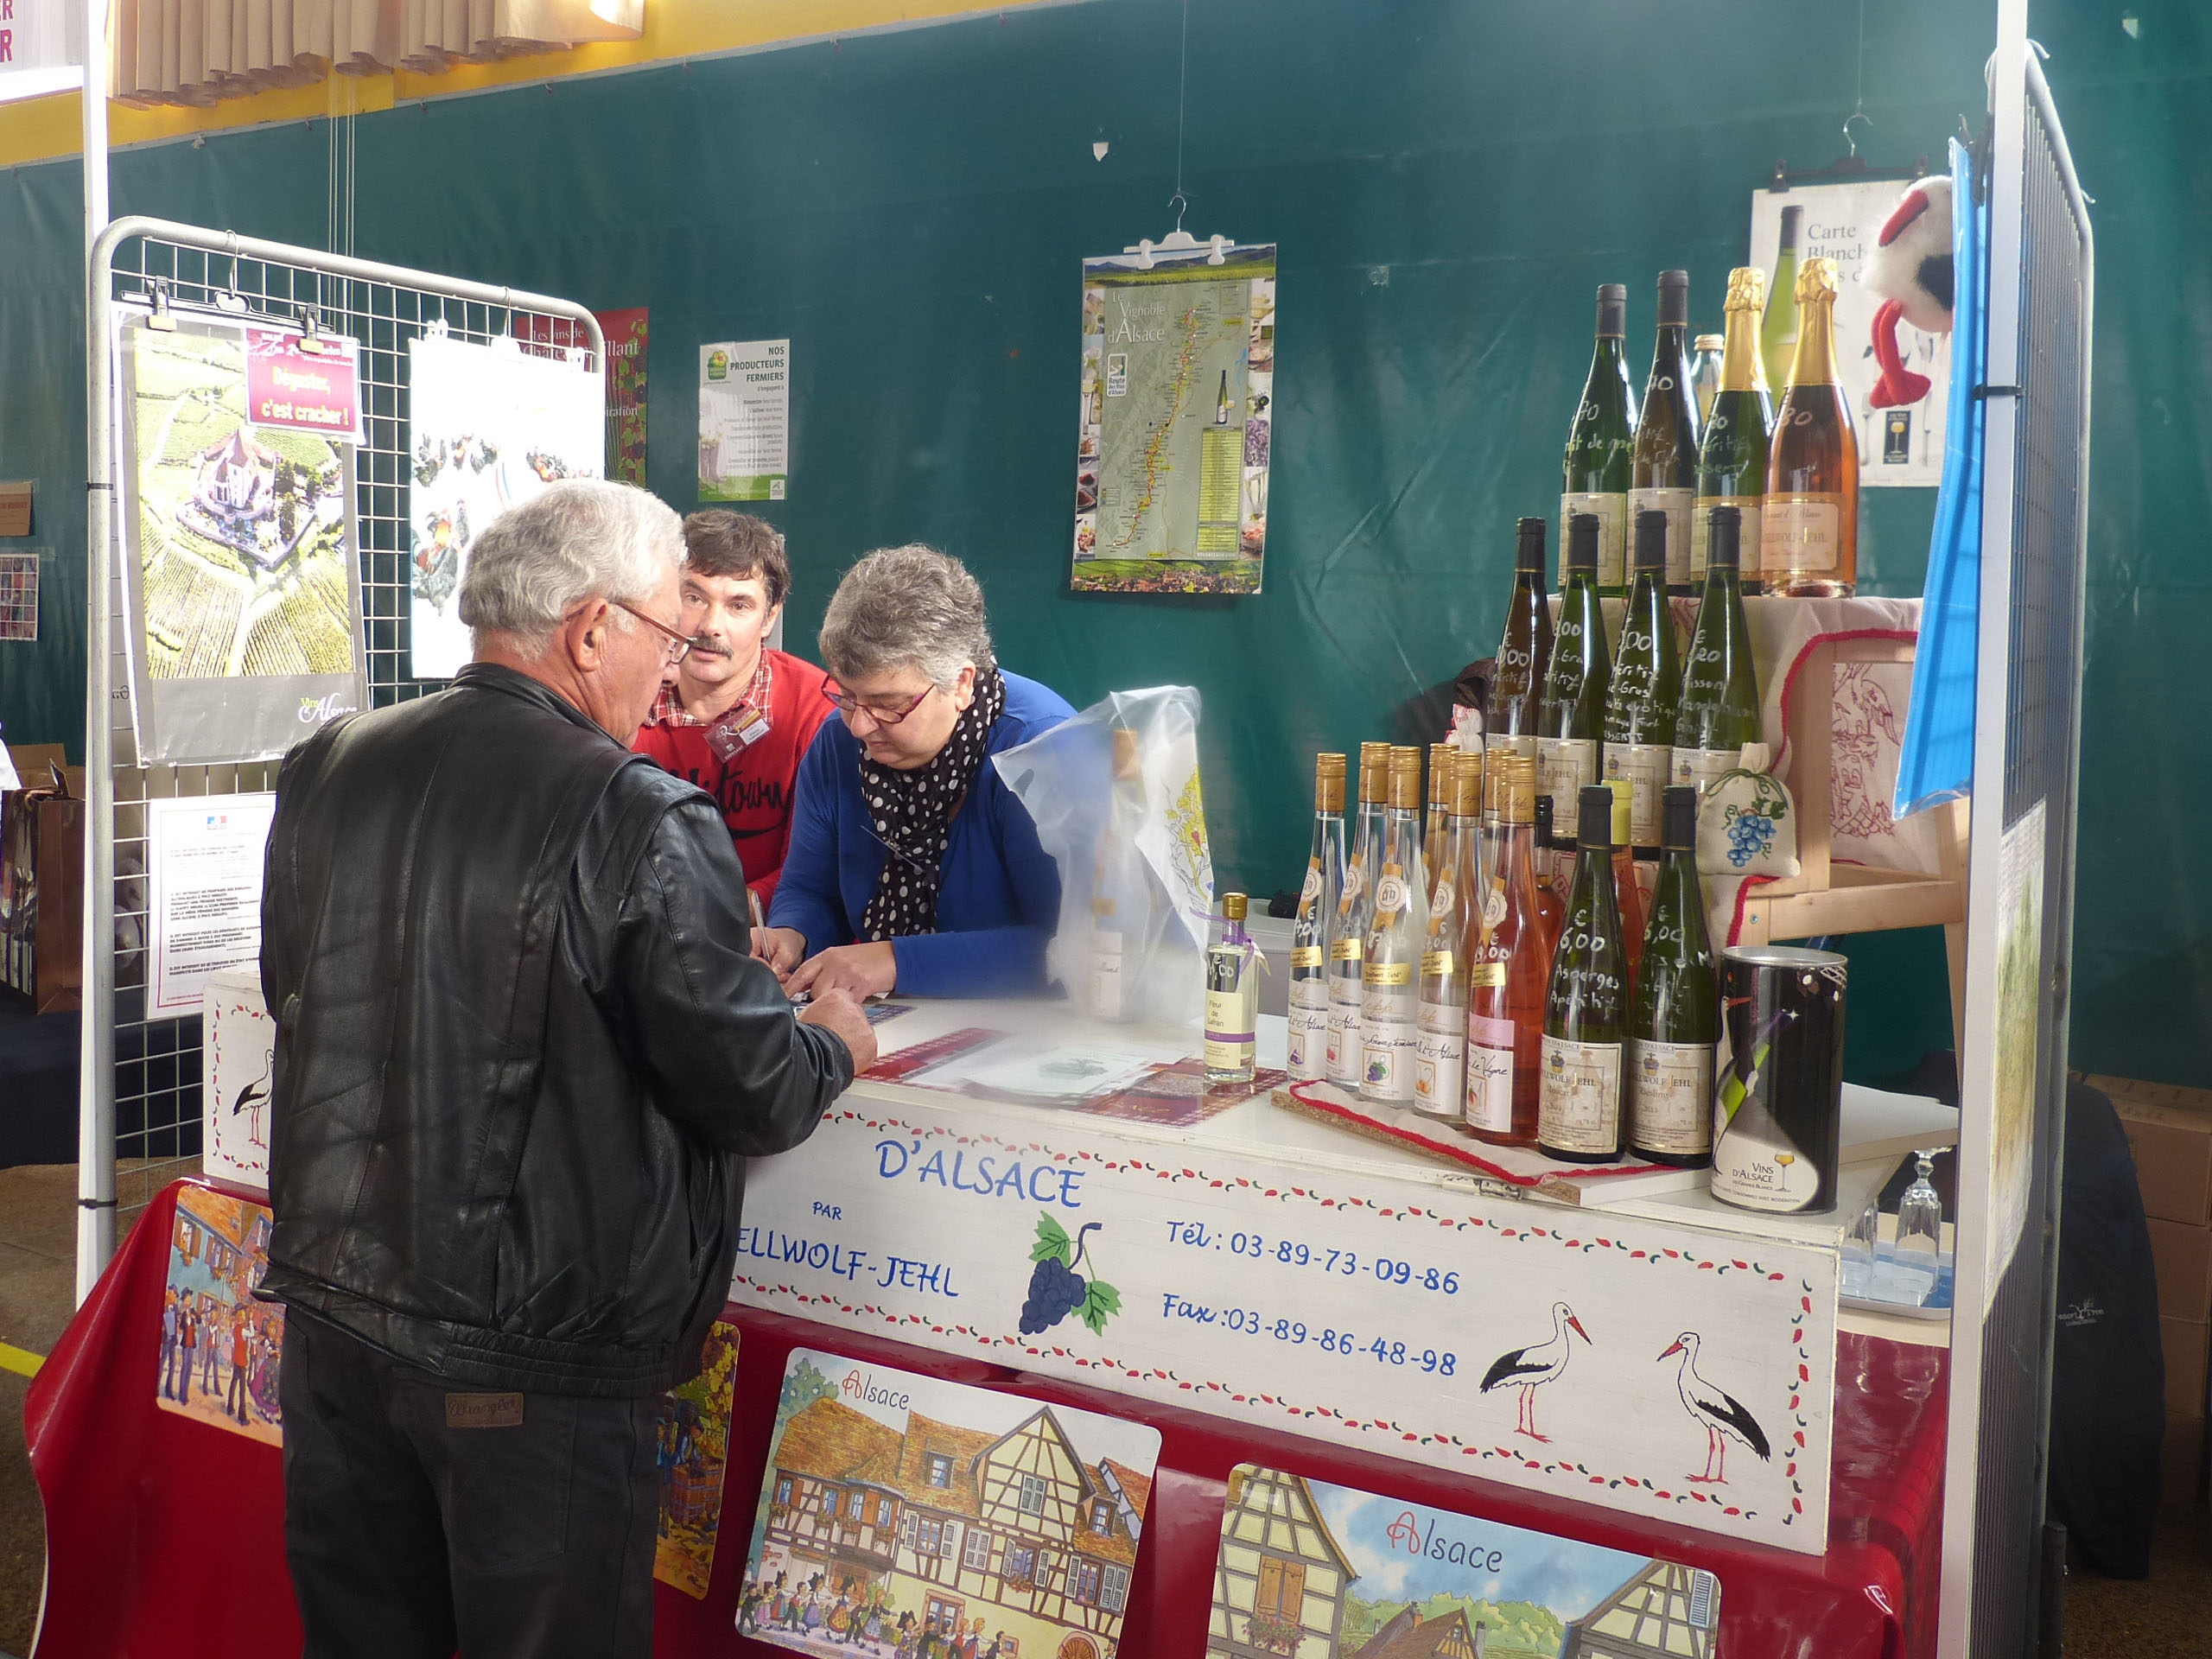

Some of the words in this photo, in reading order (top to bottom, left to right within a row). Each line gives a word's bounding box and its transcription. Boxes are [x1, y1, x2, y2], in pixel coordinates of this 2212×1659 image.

[1808, 223, 1857, 240] Carte
[1113, 290, 1124, 302] Le
[1120, 301, 1166, 321] Vignoble
[533, 330, 548, 340] Les
[550, 330, 569, 340] ins
[768, 346, 785, 356] NOS
[730, 359, 785, 372] PRODUCTEURS
[746, 372, 785, 383] FERMIERS
[261, 398, 294, 420] c'est
[295, 405, 342, 425] cracher
[1560, 926, 1605, 955] 6,00
[1209, 999, 1223, 1008] Fleur
[1573, 1072, 1597, 1087] JEHL
[1669, 1073, 1692, 1090] JEHL
[875, 1140, 1085, 1208] D'ALSACE
[1732, 1168, 1774, 1184] D'ALSACE
[1751, 1161, 1774, 1174] VINS
[812, 1200, 842, 1221] PAR
[736, 1227, 959, 1297] ELLWOLF-JEHL
[1230, 1232, 1460, 1294] 03-89-73-09-86
[1228, 1308, 1457, 1376] 03-89-86-48-98
[842, 1370, 910, 1410] Alsace
[1386, 1510, 1503, 1573] Alsace
